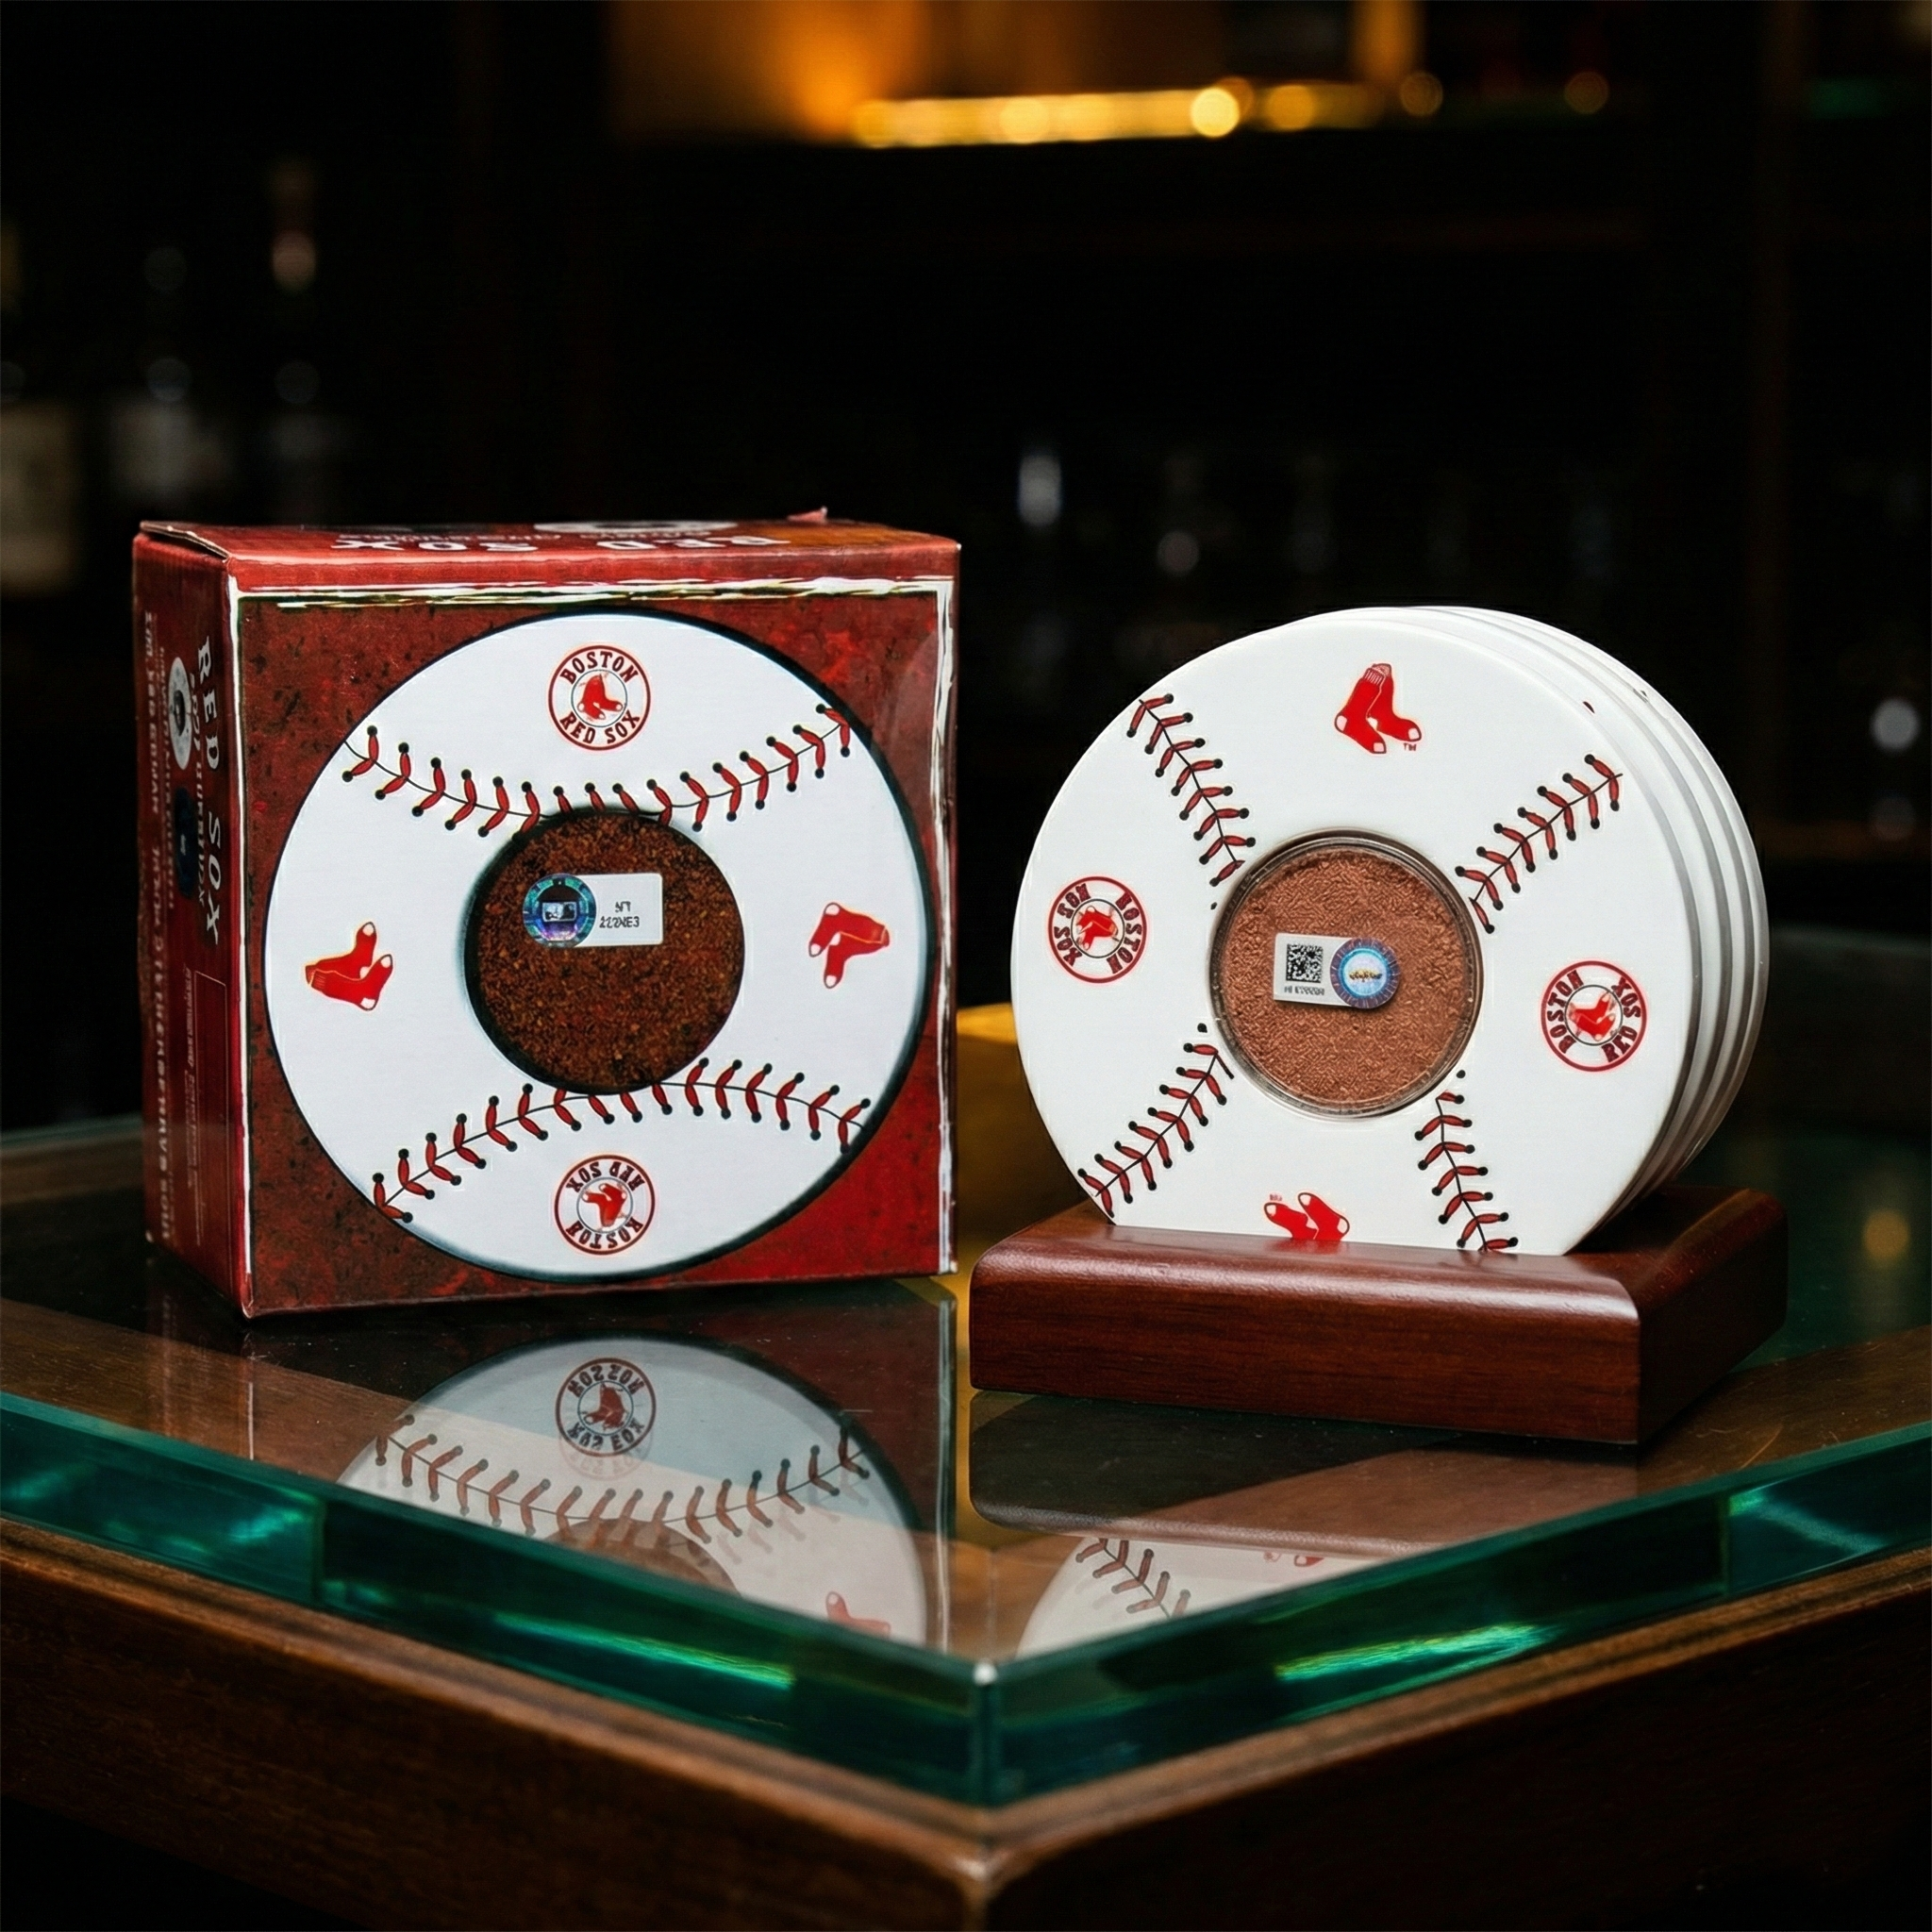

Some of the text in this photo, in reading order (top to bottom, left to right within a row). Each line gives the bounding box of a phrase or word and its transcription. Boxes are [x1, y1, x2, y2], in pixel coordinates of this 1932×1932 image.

[559, 651, 639, 685] BOSTON
[559, 709, 641, 744] RED SOX
[198, 636, 222, 945] RED SOX
[1547, 970, 1584, 1054] BOSTON
[1601, 976, 1641, 1063] RED SOX
